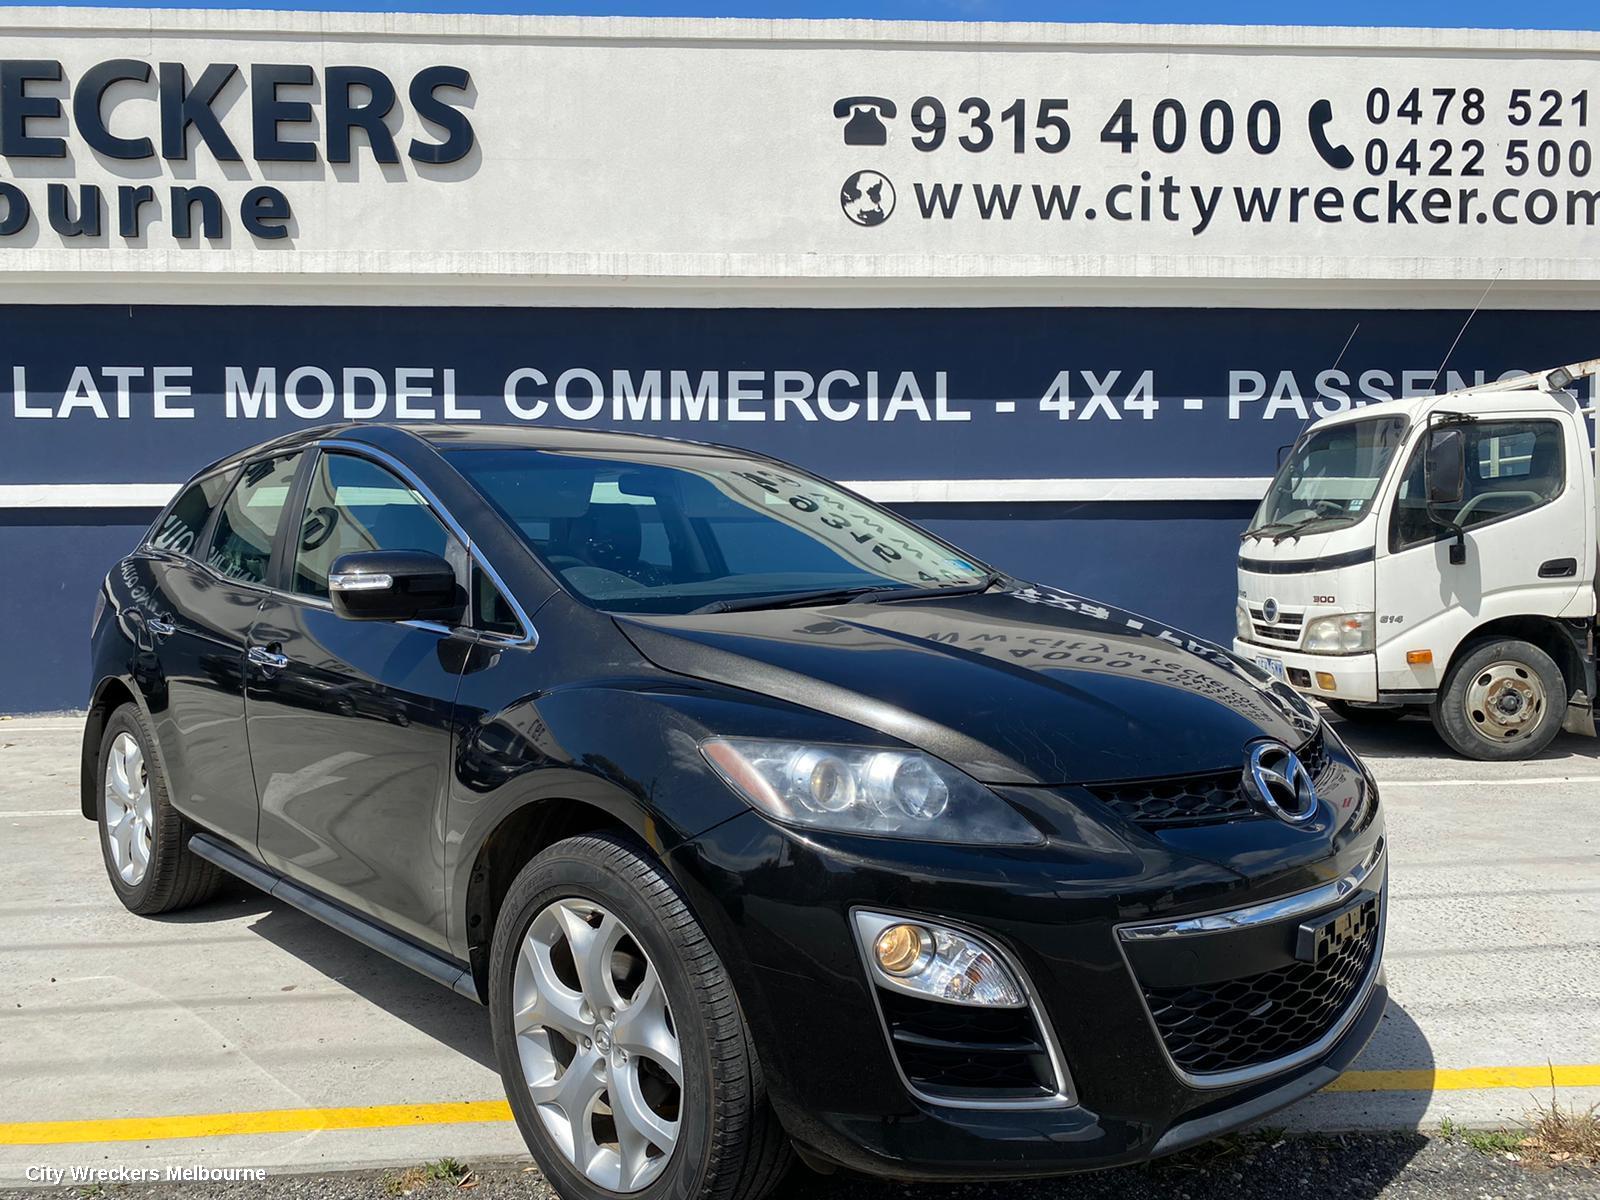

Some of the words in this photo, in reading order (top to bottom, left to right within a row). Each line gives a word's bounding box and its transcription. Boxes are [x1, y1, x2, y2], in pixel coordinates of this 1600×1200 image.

[0, 58, 476, 166] ECKERS
[910, 96, 1071, 154] 9315
[1100, 98, 1281, 155] 4000
[1366, 87, 1485, 126] 0478
[1507, 88, 1588, 127] 521
[1365, 138, 1485, 177] 0422
[1505, 139, 1592, 178] 500
[913, 170, 1600, 236] www.citywrecker.com
[12, 366, 196, 419] LATE
[224, 366, 482, 420] MODEL
[504, 368, 972, 422] COMMERCIAL
[1039, 370, 1160, 420] 4X4
